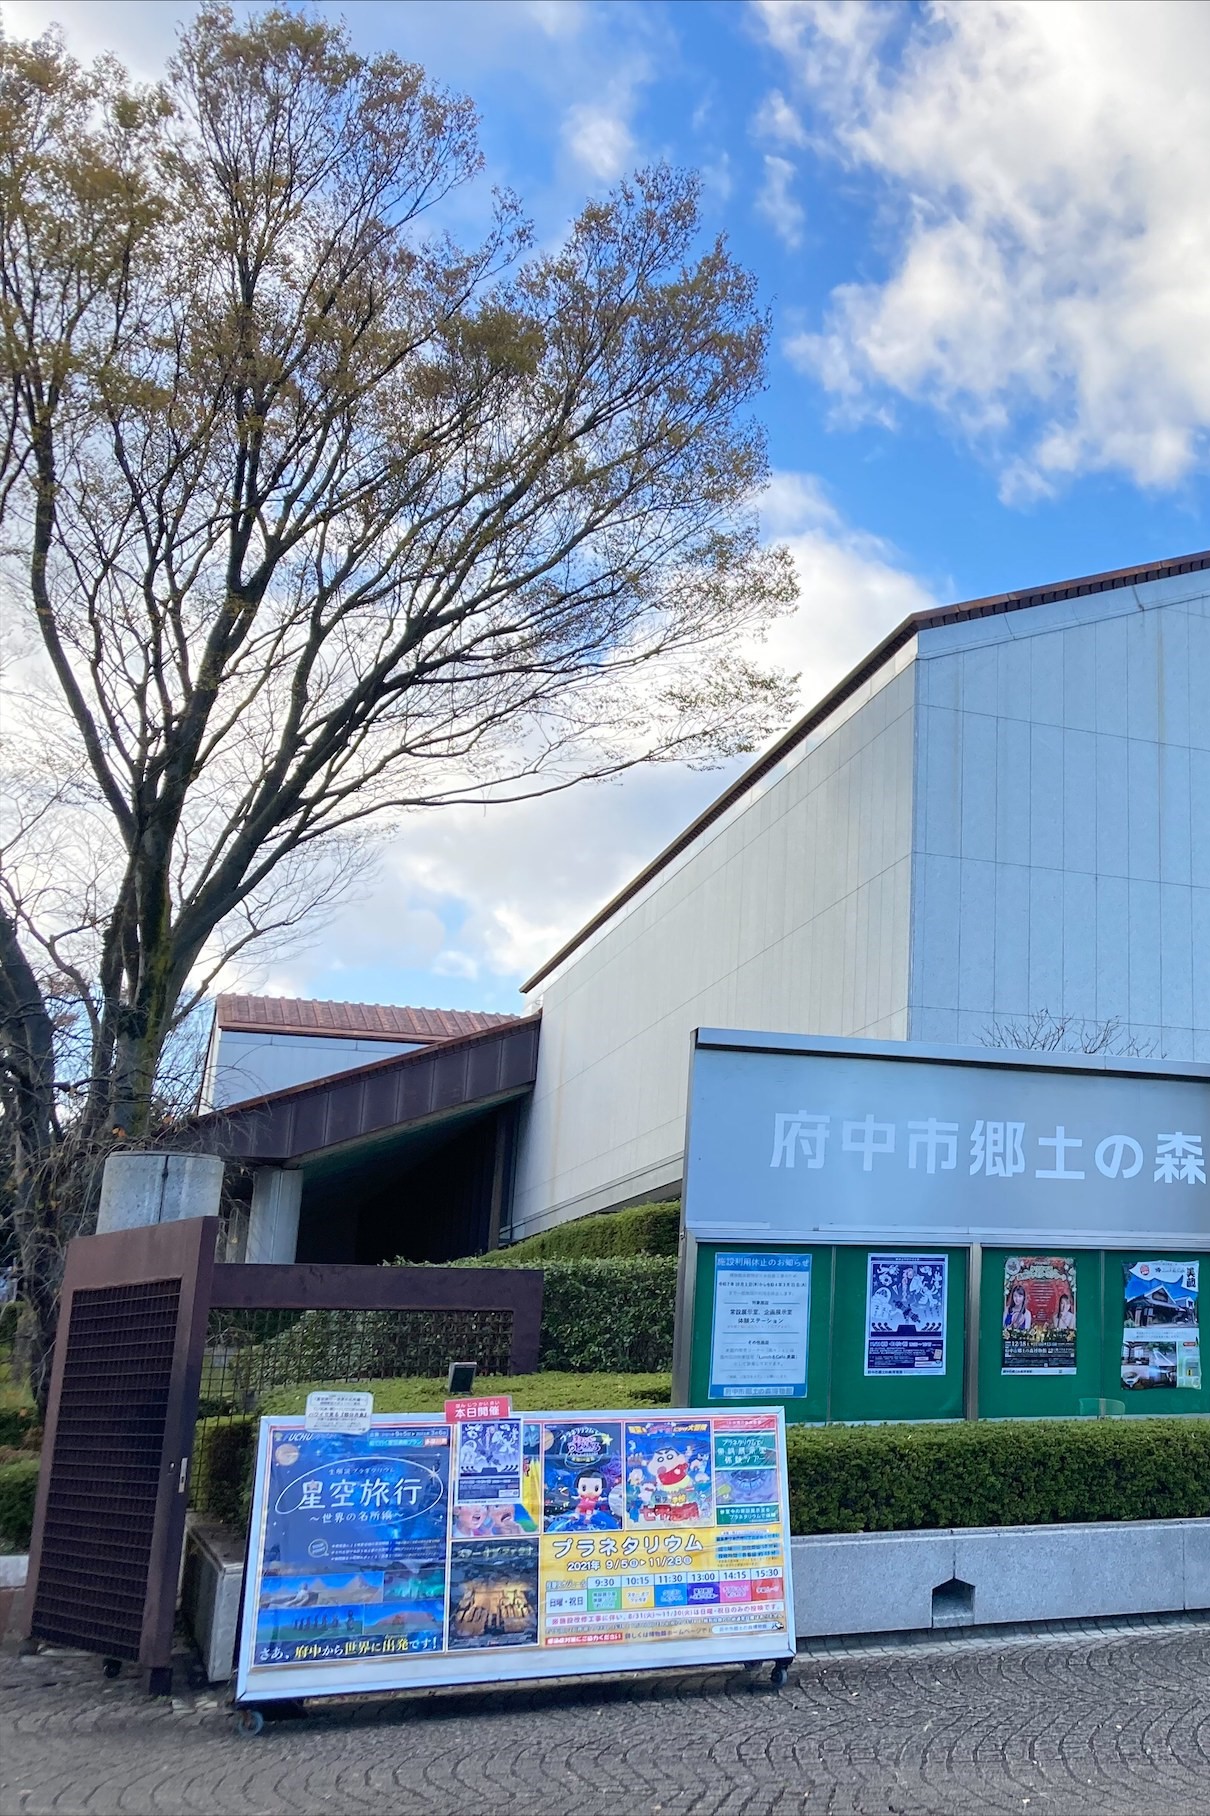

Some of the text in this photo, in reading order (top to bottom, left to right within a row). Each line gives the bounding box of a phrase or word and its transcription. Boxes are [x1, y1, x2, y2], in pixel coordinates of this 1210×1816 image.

[717, 1257, 809, 1267] 施設利用休止のお知らせ
[455, 1407, 500, 1418] 本日開催
[299, 1477, 423, 1511] 星空旅行
[552, 1534, 703, 1559] プラネタリウム
[567, 1560, 601, 1572] 2021年
[692, 1572, 715, 1582] 13:00
[724, 1570, 747, 1580] 14:15
[756, 1568, 779, 1577] 15:30
[595, 1577, 615, 1587] 9:30
[626, 1576, 650, 1585] 10:15
[659, 1574, 683, 1583] 11:30
[549, 1596, 584, 1608] 日曜・祝日
